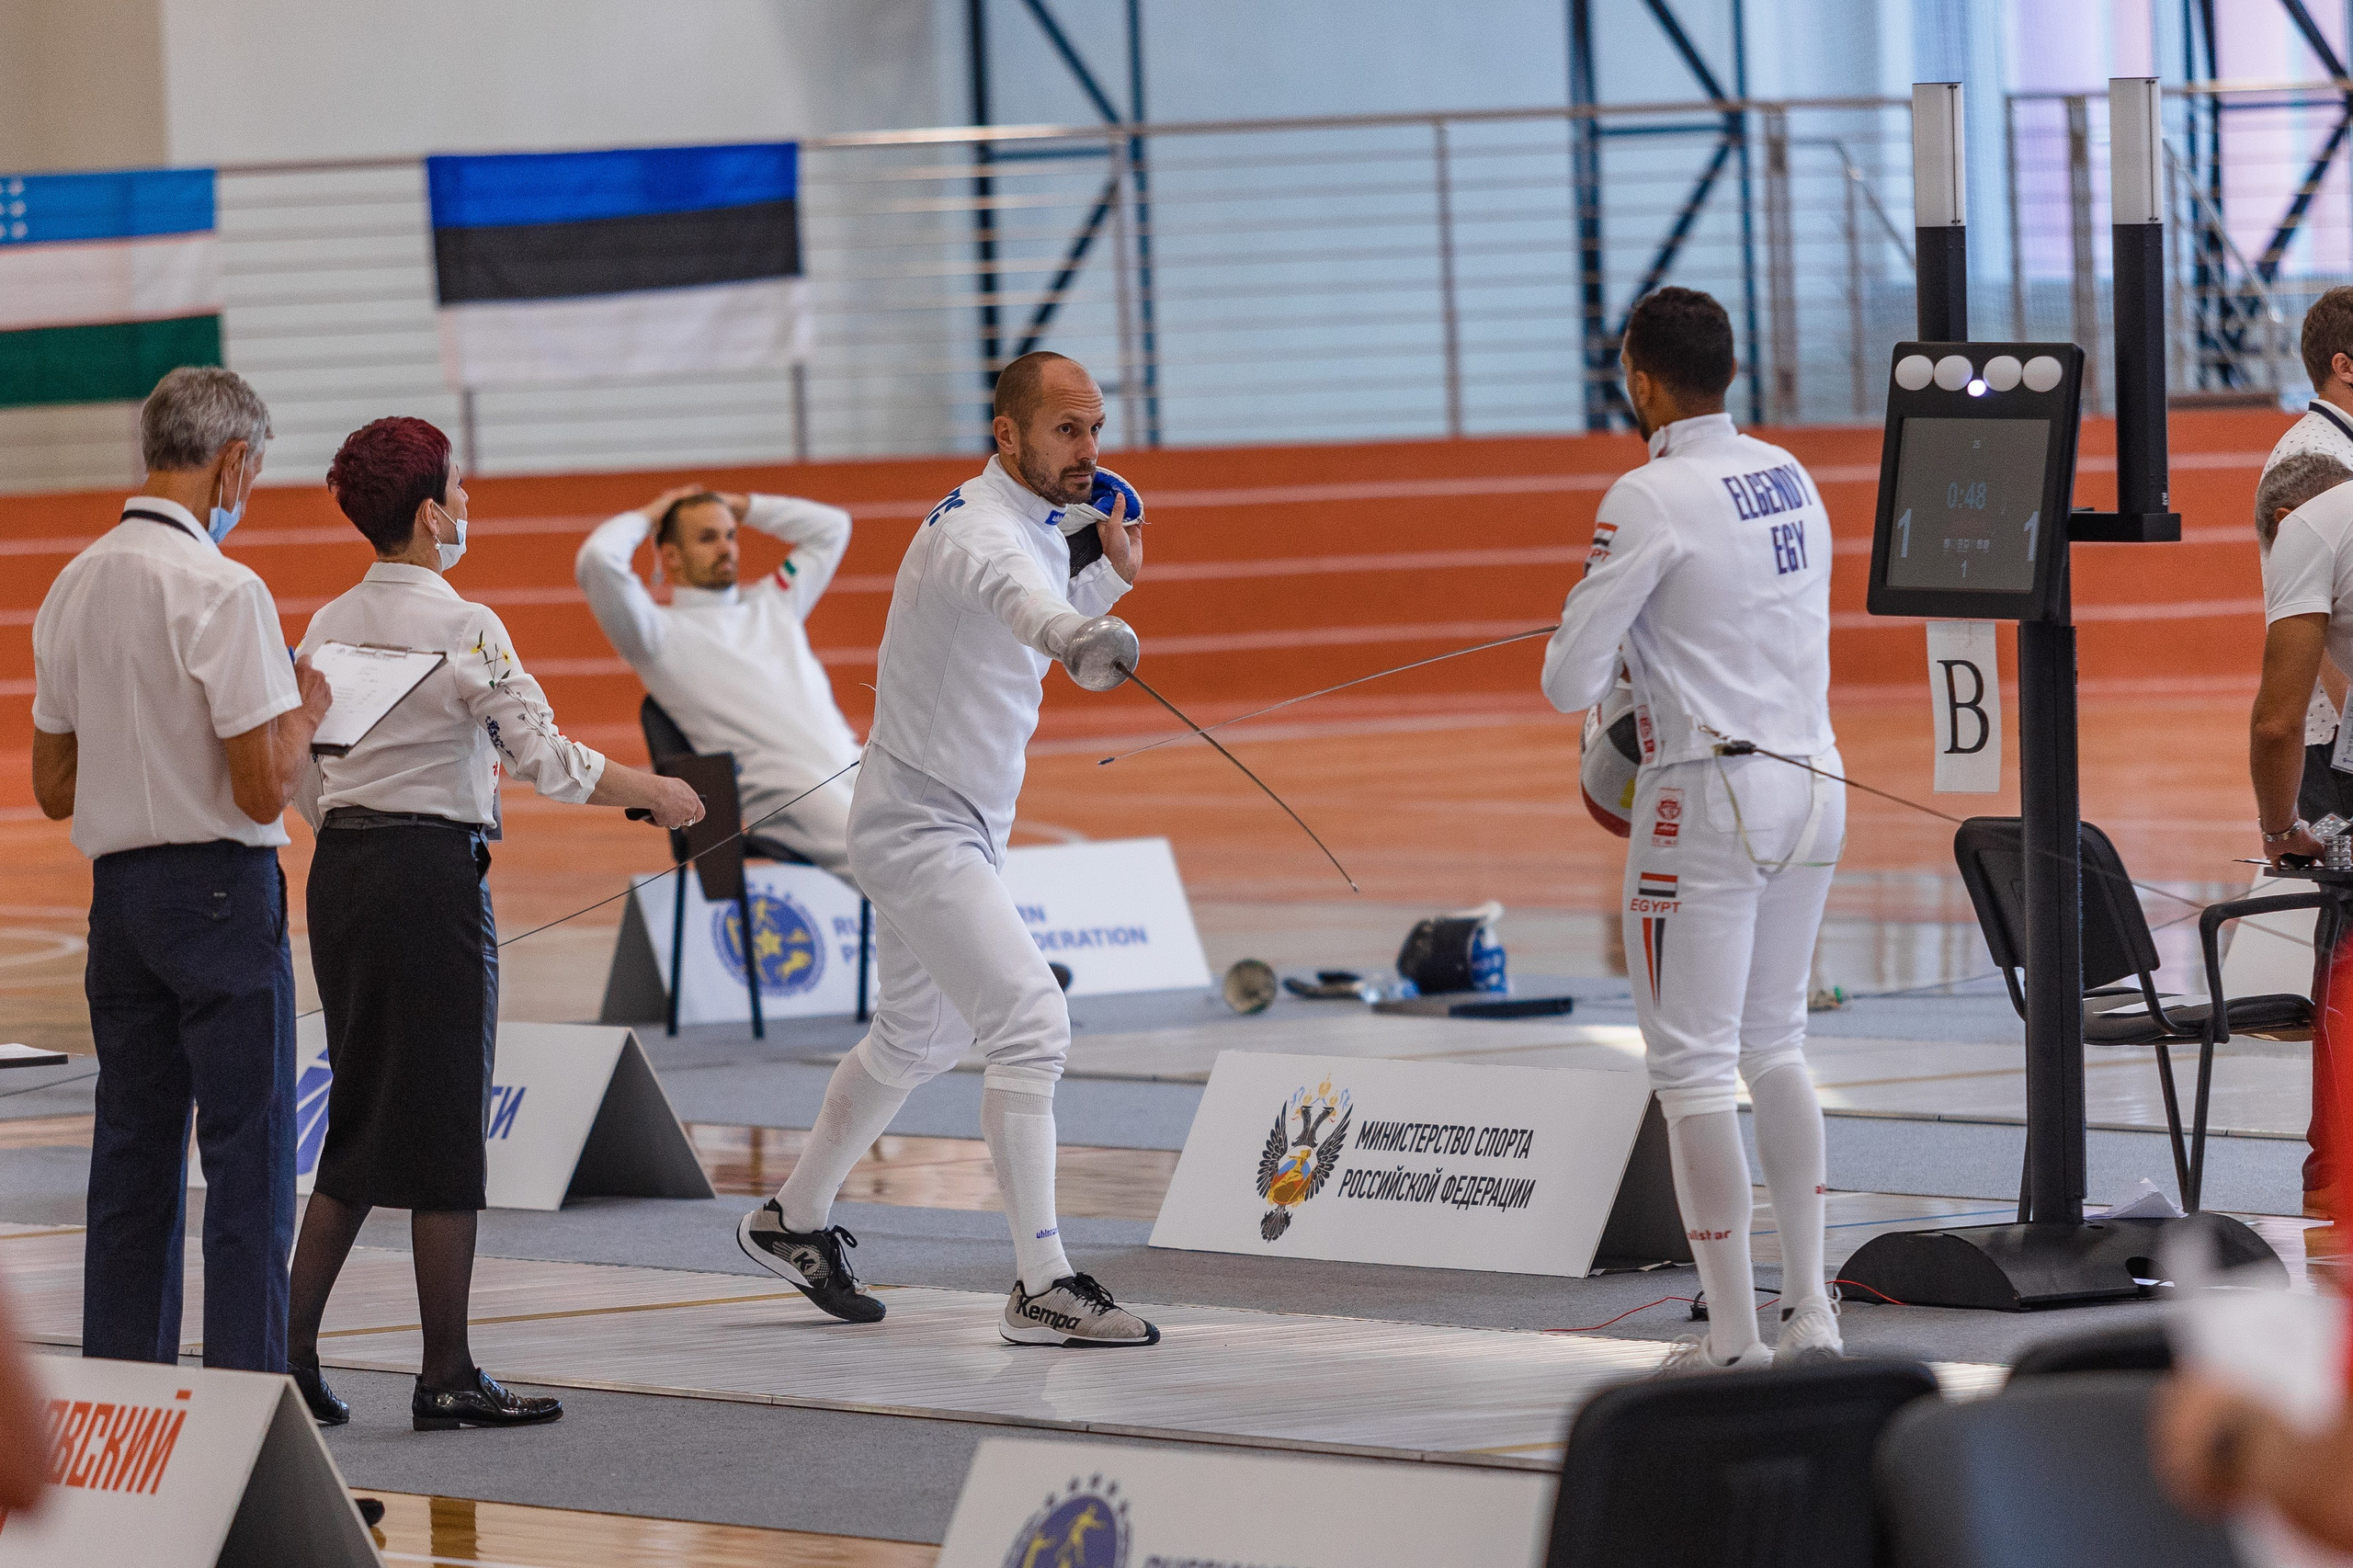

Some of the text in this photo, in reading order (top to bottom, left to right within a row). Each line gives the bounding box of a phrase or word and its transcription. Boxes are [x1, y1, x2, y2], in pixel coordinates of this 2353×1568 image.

[1722, 462, 1812, 520] ELGENDY
[1947, 482, 1986, 509] 0:48
[1770, 521, 1807, 574] EGY
[1897, 507, 1912, 558] 1
[2024, 511, 2040, 562] 1
[1937, 659, 1989, 754] B
[1630, 898, 1682, 914] EGYPT
[1030, 926, 1148, 950] DERATION
[1355, 1120, 1534, 1159] МИНИСТЕРСТВО СПОРТА
[1337, 1165, 1536, 1212] РОССИЙСКОЙ ФЕДЕРАЦИИ
[1016, 1295, 1082, 1330] Kempa
